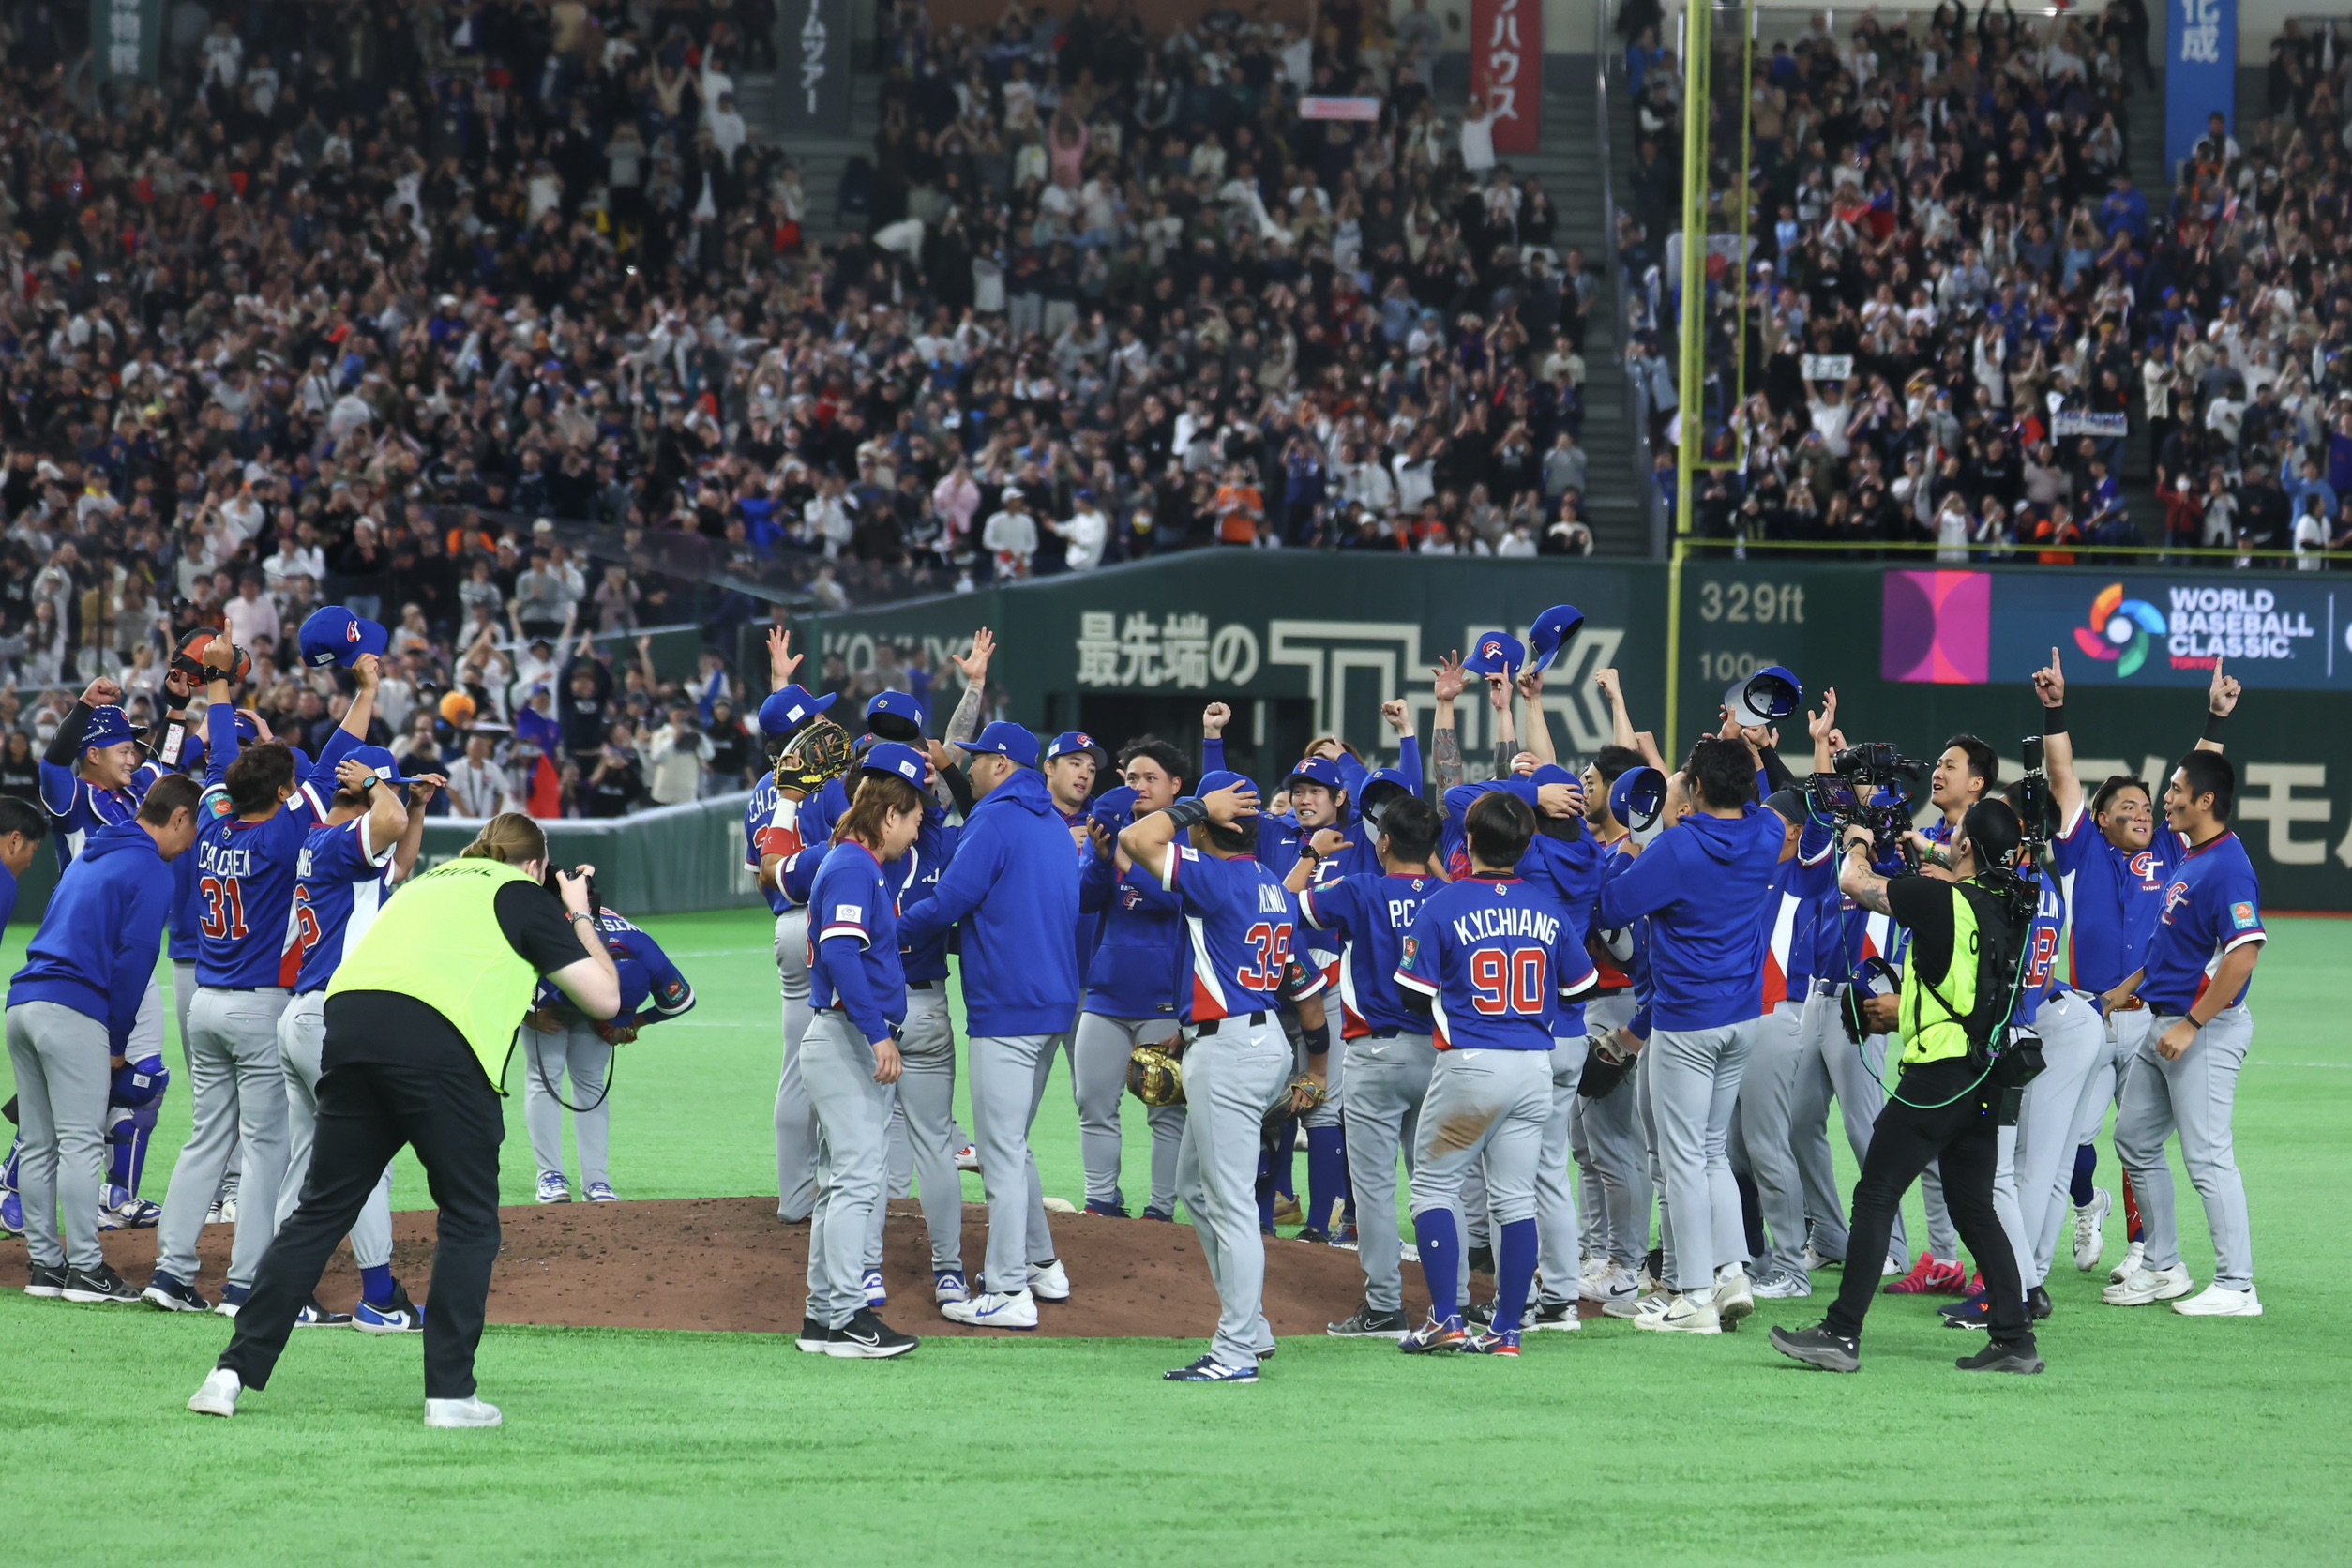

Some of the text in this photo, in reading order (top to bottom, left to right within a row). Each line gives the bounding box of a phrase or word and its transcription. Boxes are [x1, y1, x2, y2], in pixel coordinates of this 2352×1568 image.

[1490, 0, 1521, 120] ハウス
[2181, 0, 2220, 63] 化成
[1700, 581, 1805, 623] 329ft
[2169, 611, 2314, 638] BASEBALL
[2170, 587, 2275, 613] WORLD
[1076, 611, 1259, 689] 最先端の
[2168, 634, 2291, 659] CLASSIC
[2169, 656, 2217, 671] TOKYO
[1269, 619, 1626, 751] THK
[200, 876, 249, 941] 31
[1453, 907, 1560, 947] K.Y.CHIANG
[1236, 922, 1293, 992] 39
[1470, 947, 1547, 1015] 90
